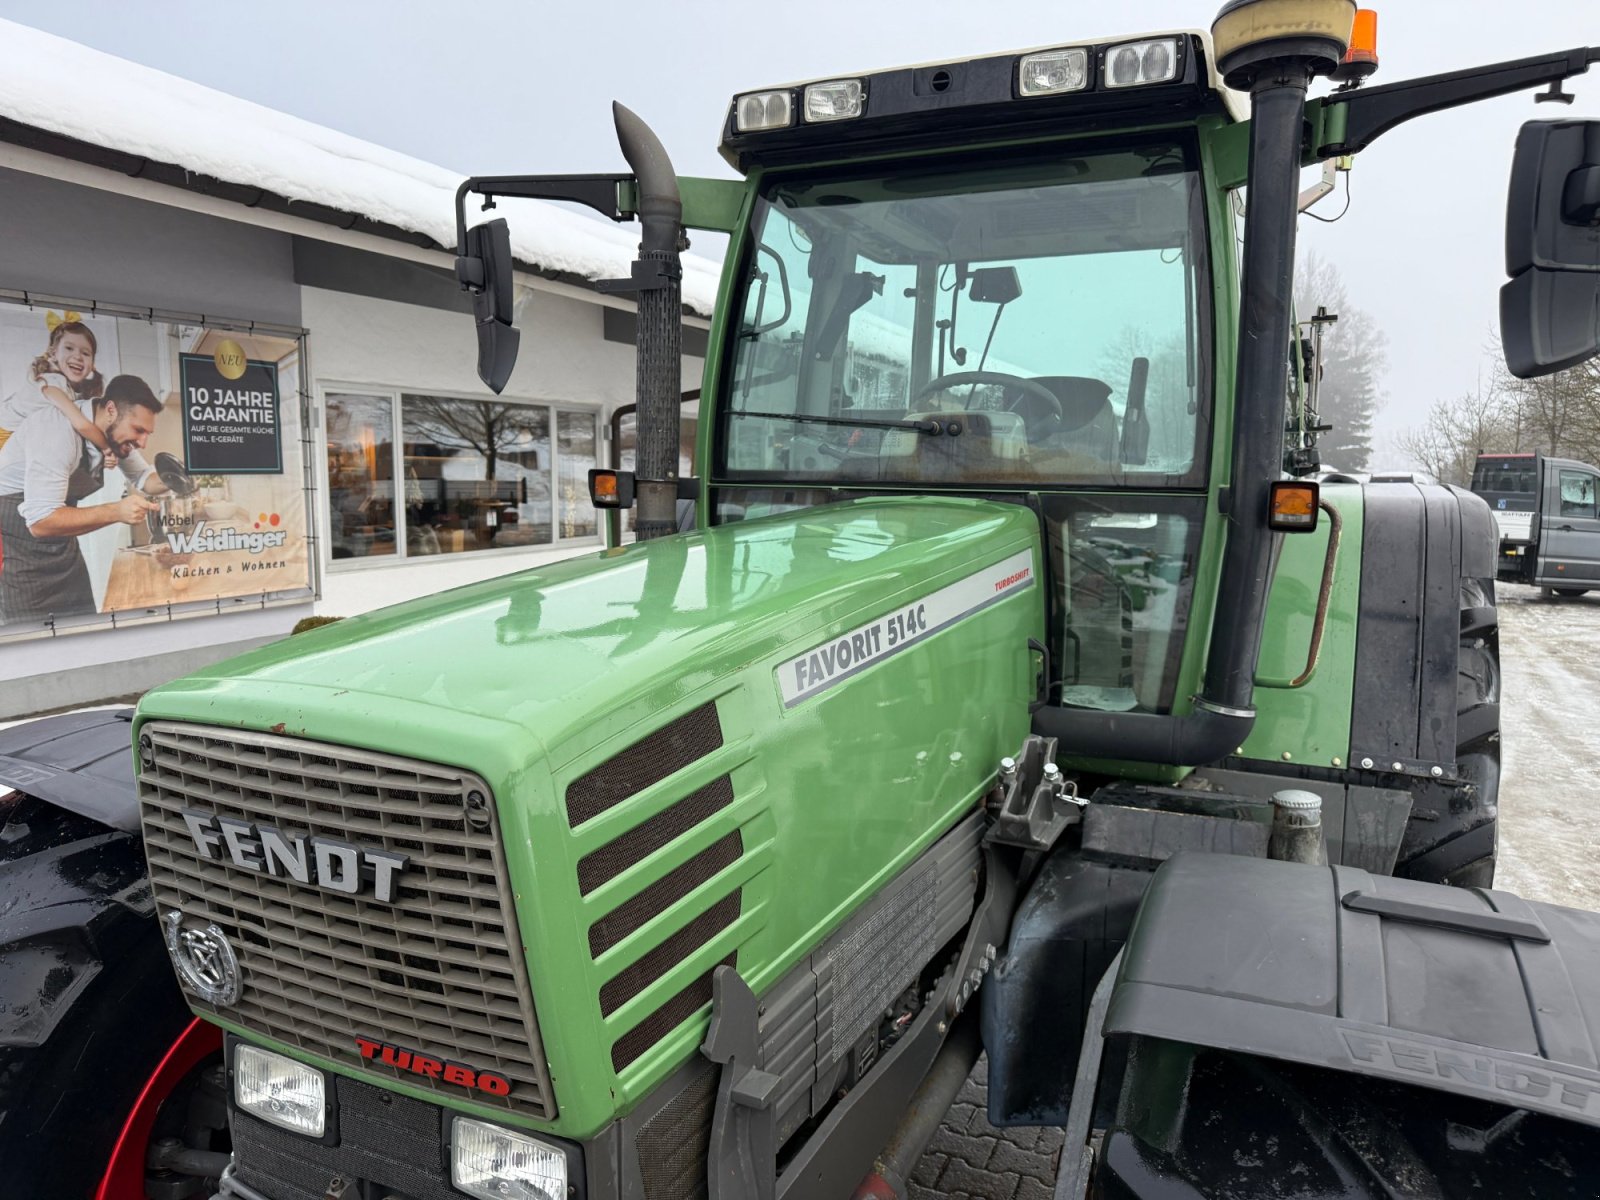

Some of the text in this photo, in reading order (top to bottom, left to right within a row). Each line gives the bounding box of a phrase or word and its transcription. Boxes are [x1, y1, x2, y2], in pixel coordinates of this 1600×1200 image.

[220, 353, 243, 367] NEU
[188, 387, 273, 408] 10 JAHRE
[189, 406, 274, 424] GARANTIE
[191, 424, 275, 435] AUF DIE GESAMTE KÜCHE
[191, 434, 245, 444] INKL. E-GERÄTE
[157, 513, 195, 527] Möbel
[167, 519, 287, 554] Weidinger
[173, 565, 220, 579] Küchen
[241, 560, 286, 573] Wohnen
[794, 567, 1030, 692] FAVORIT 514C TURBOSHIFT
[183, 809, 409, 902] FENDT
[355, 1035, 512, 1096] TURBO
[1341, 1032, 1600, 1111] FENDT
